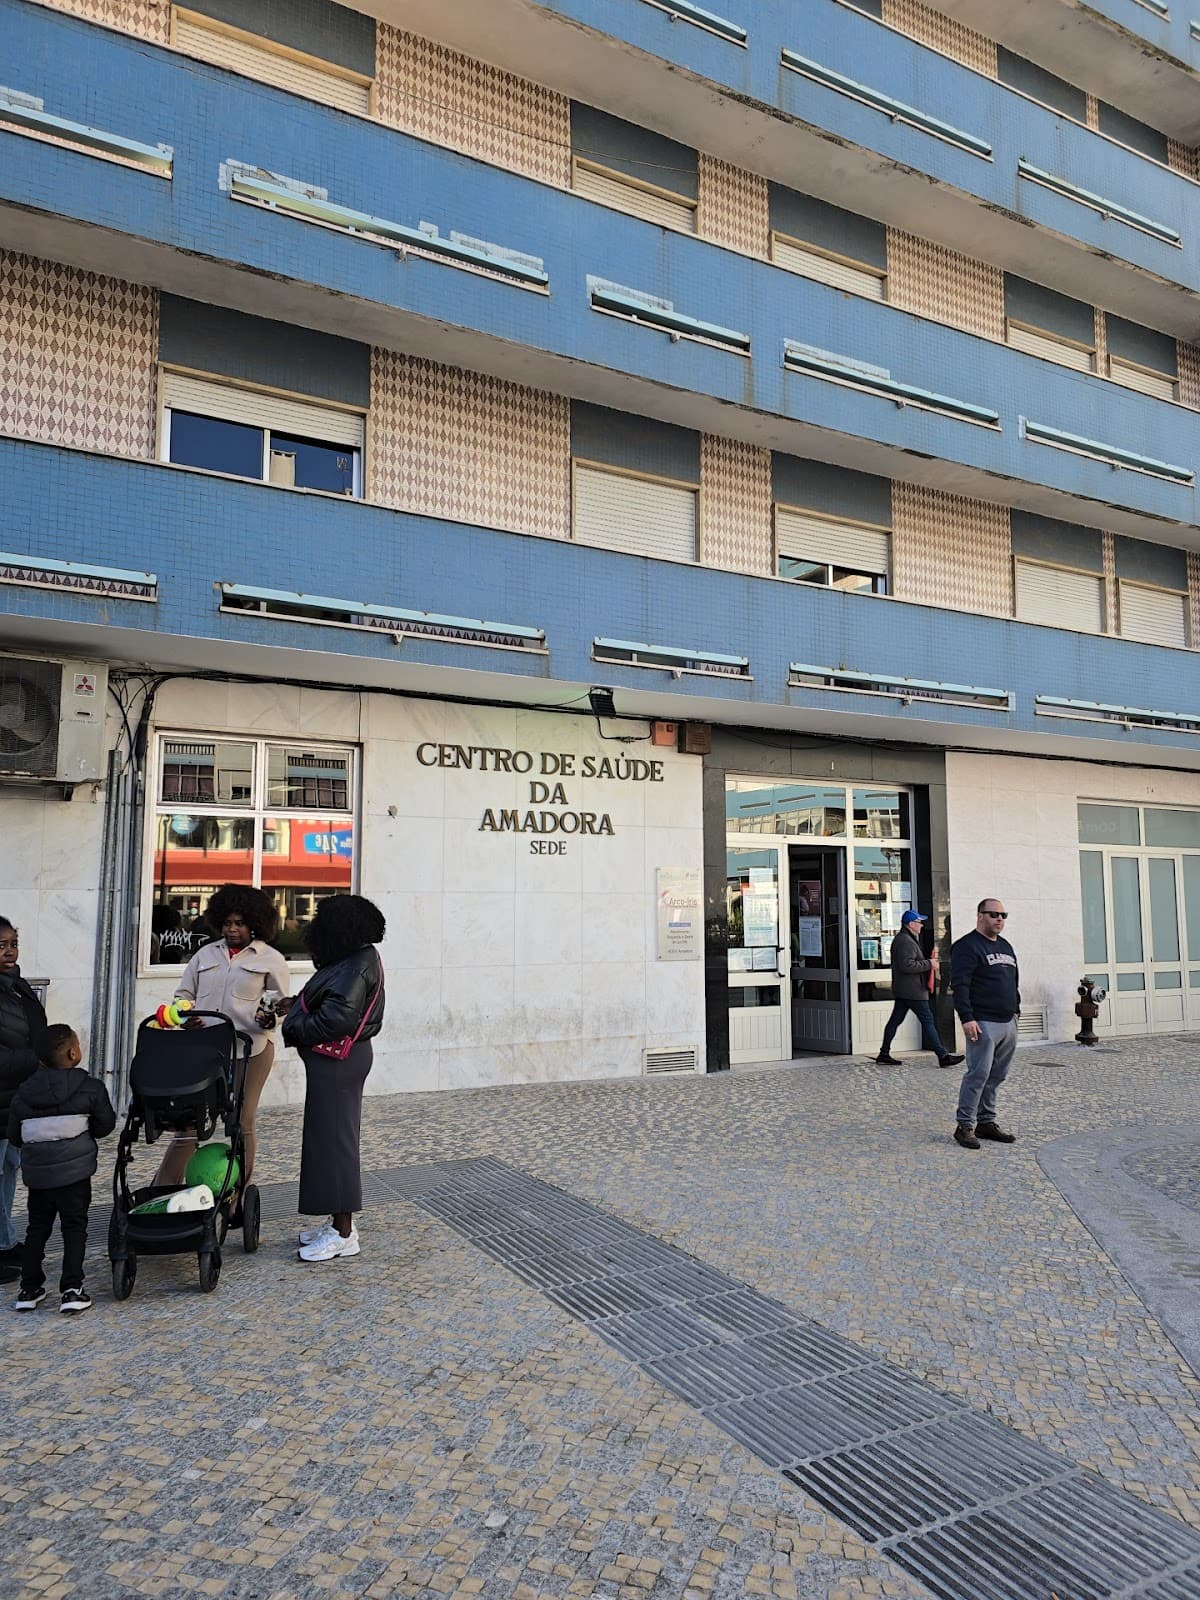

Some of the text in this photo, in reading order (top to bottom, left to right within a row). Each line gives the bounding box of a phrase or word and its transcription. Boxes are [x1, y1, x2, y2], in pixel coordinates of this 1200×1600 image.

[416, 742, 664, 782] CENTRO DE SAÚDE
[529, 781, 569, 805] DA
[478, 808, 615, 836] AMADORA
[530, 840, 567, 855] SEDE
